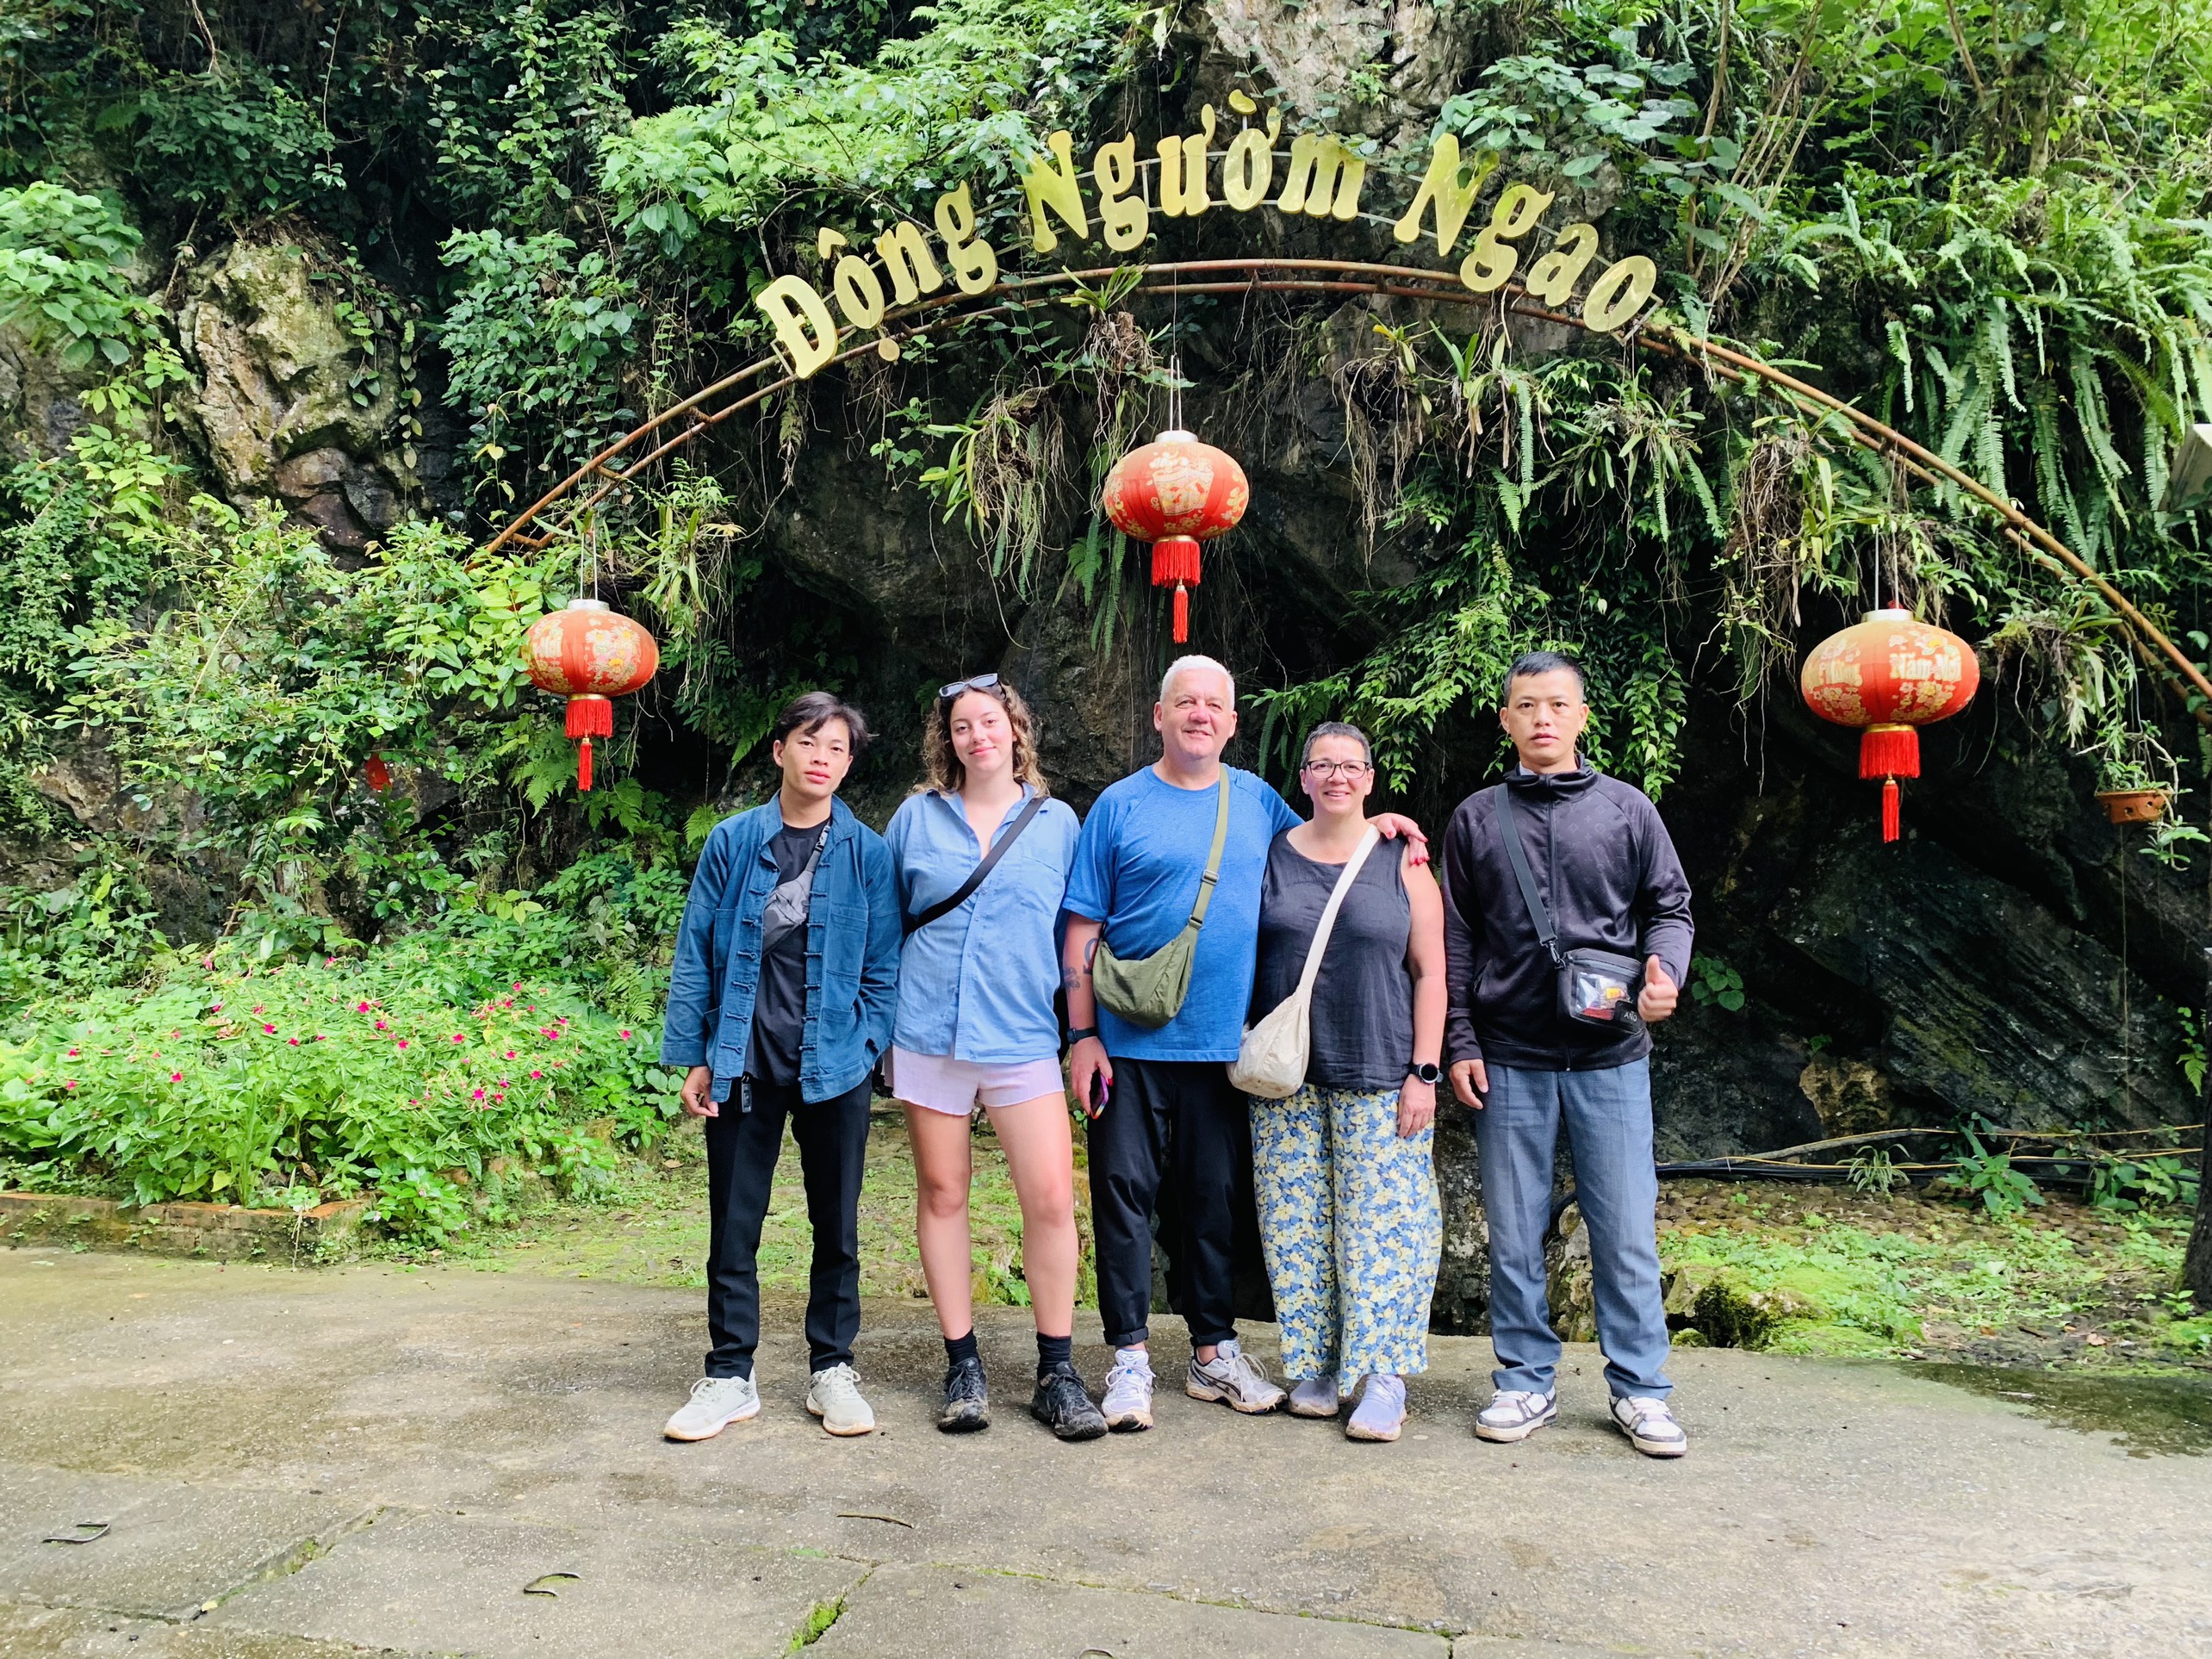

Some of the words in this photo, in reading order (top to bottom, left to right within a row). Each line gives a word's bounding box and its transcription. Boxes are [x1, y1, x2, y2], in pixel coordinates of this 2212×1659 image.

[756, 180, 998, 379] Động
[1012, 89, 1366, 252] Ngườm
[1394, 132, 1656, 332] Ngao
